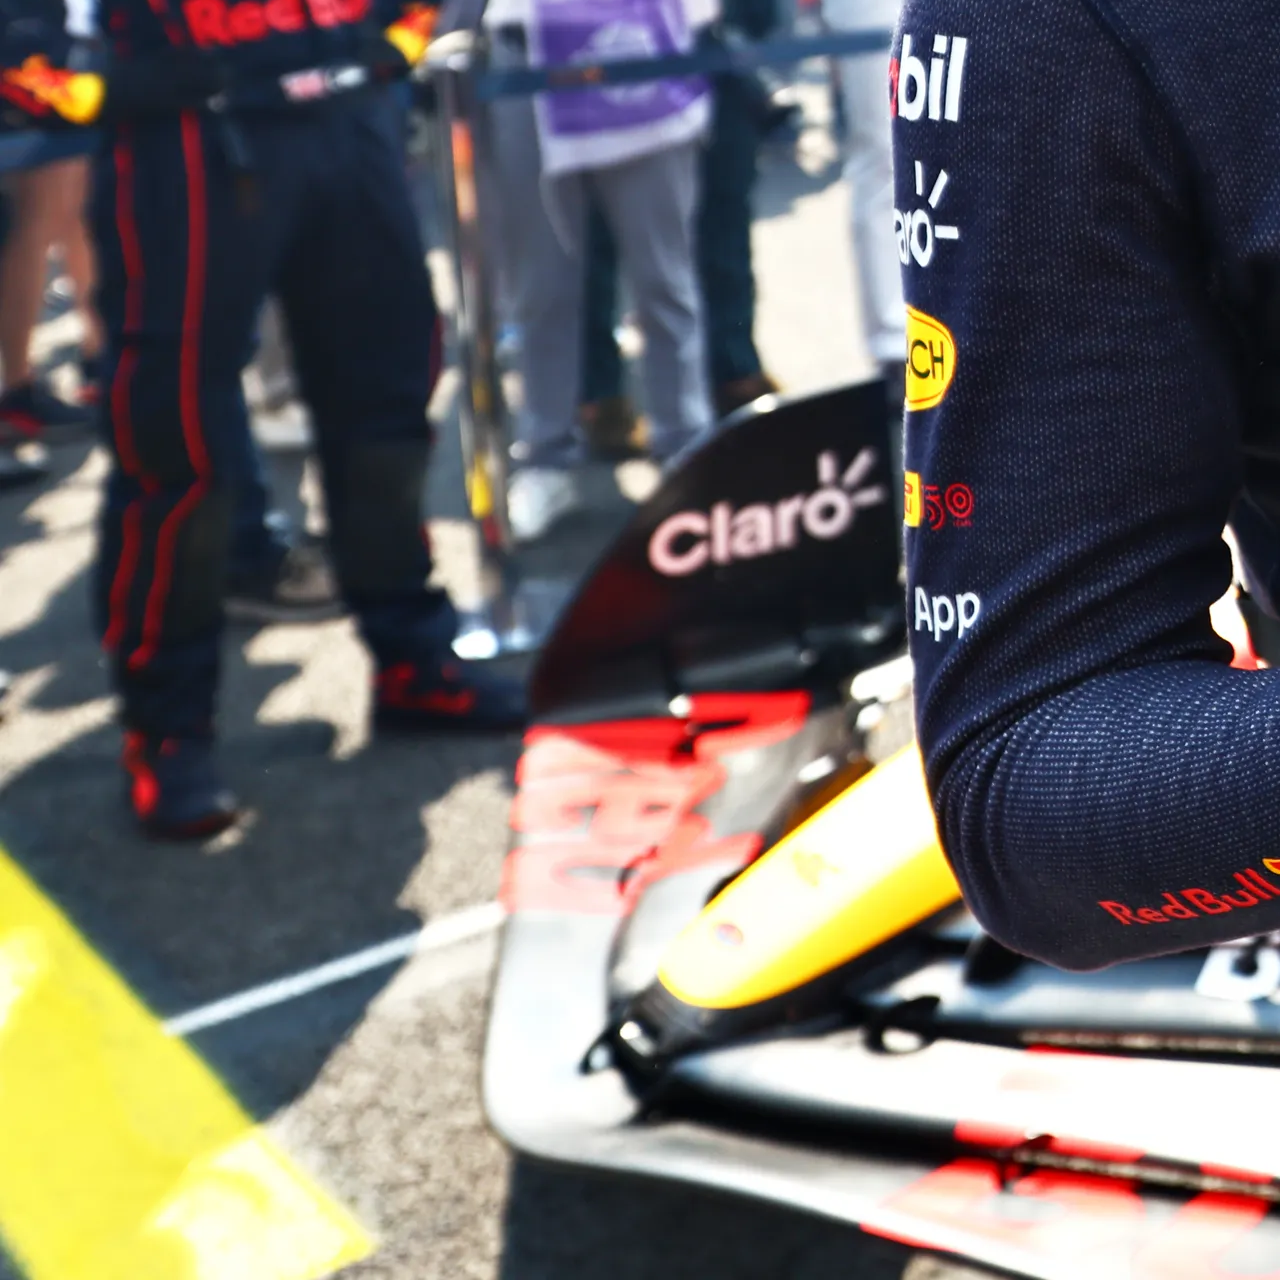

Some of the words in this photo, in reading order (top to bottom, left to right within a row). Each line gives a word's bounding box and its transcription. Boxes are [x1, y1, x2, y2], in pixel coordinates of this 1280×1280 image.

[906, 338, 945, 380] CH
[647, 486, 853, 577] Claro
[914, 585, 981, 642] App
